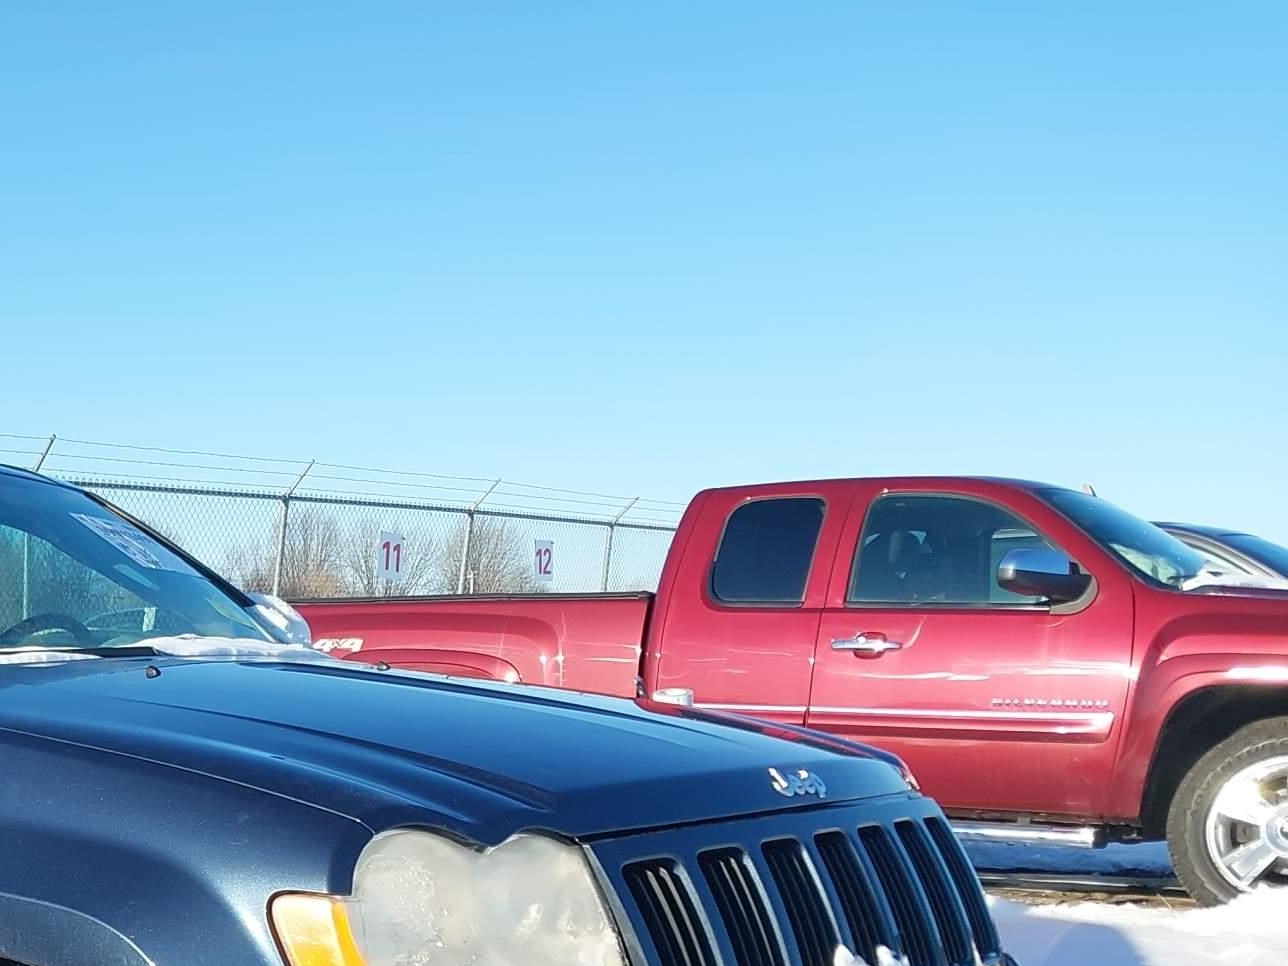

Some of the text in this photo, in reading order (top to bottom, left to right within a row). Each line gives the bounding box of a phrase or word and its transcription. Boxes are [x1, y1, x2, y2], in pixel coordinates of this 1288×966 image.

[382, 541, 402, 573] 11
[535, 548, 553, 575] 12
[768, 767, 827, 799] Jeep
